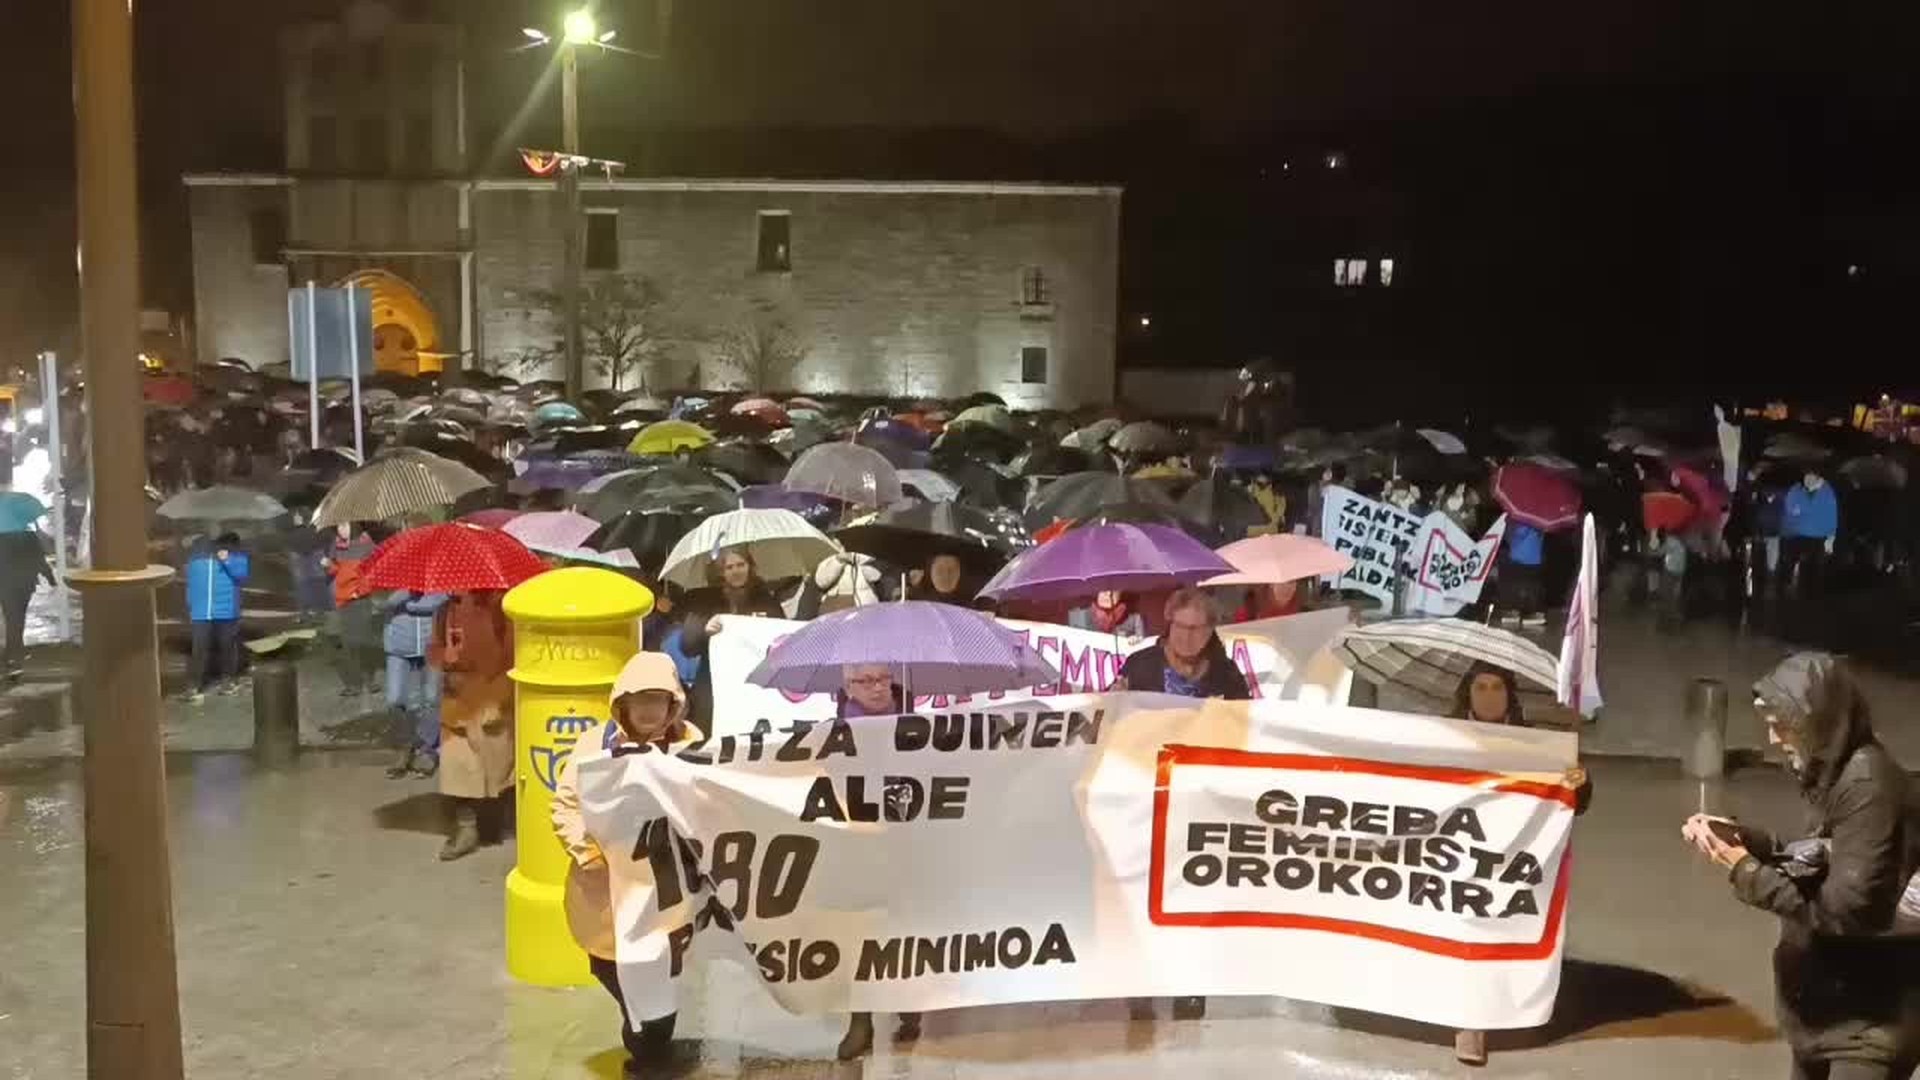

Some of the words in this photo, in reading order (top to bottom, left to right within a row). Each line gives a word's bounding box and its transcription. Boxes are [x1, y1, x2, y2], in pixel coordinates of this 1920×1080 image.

[894, 709, 1105, 752] DUINEN
[800, 776, 970, 823] ALDE
[1255, 789, 1486, 842] GREBA
[1187, 822, 1543, 885] FEMINISTA
[1182, 855, 1540, 919] OROKORRA
[855, 923, 1076, 981] MINIMOA
